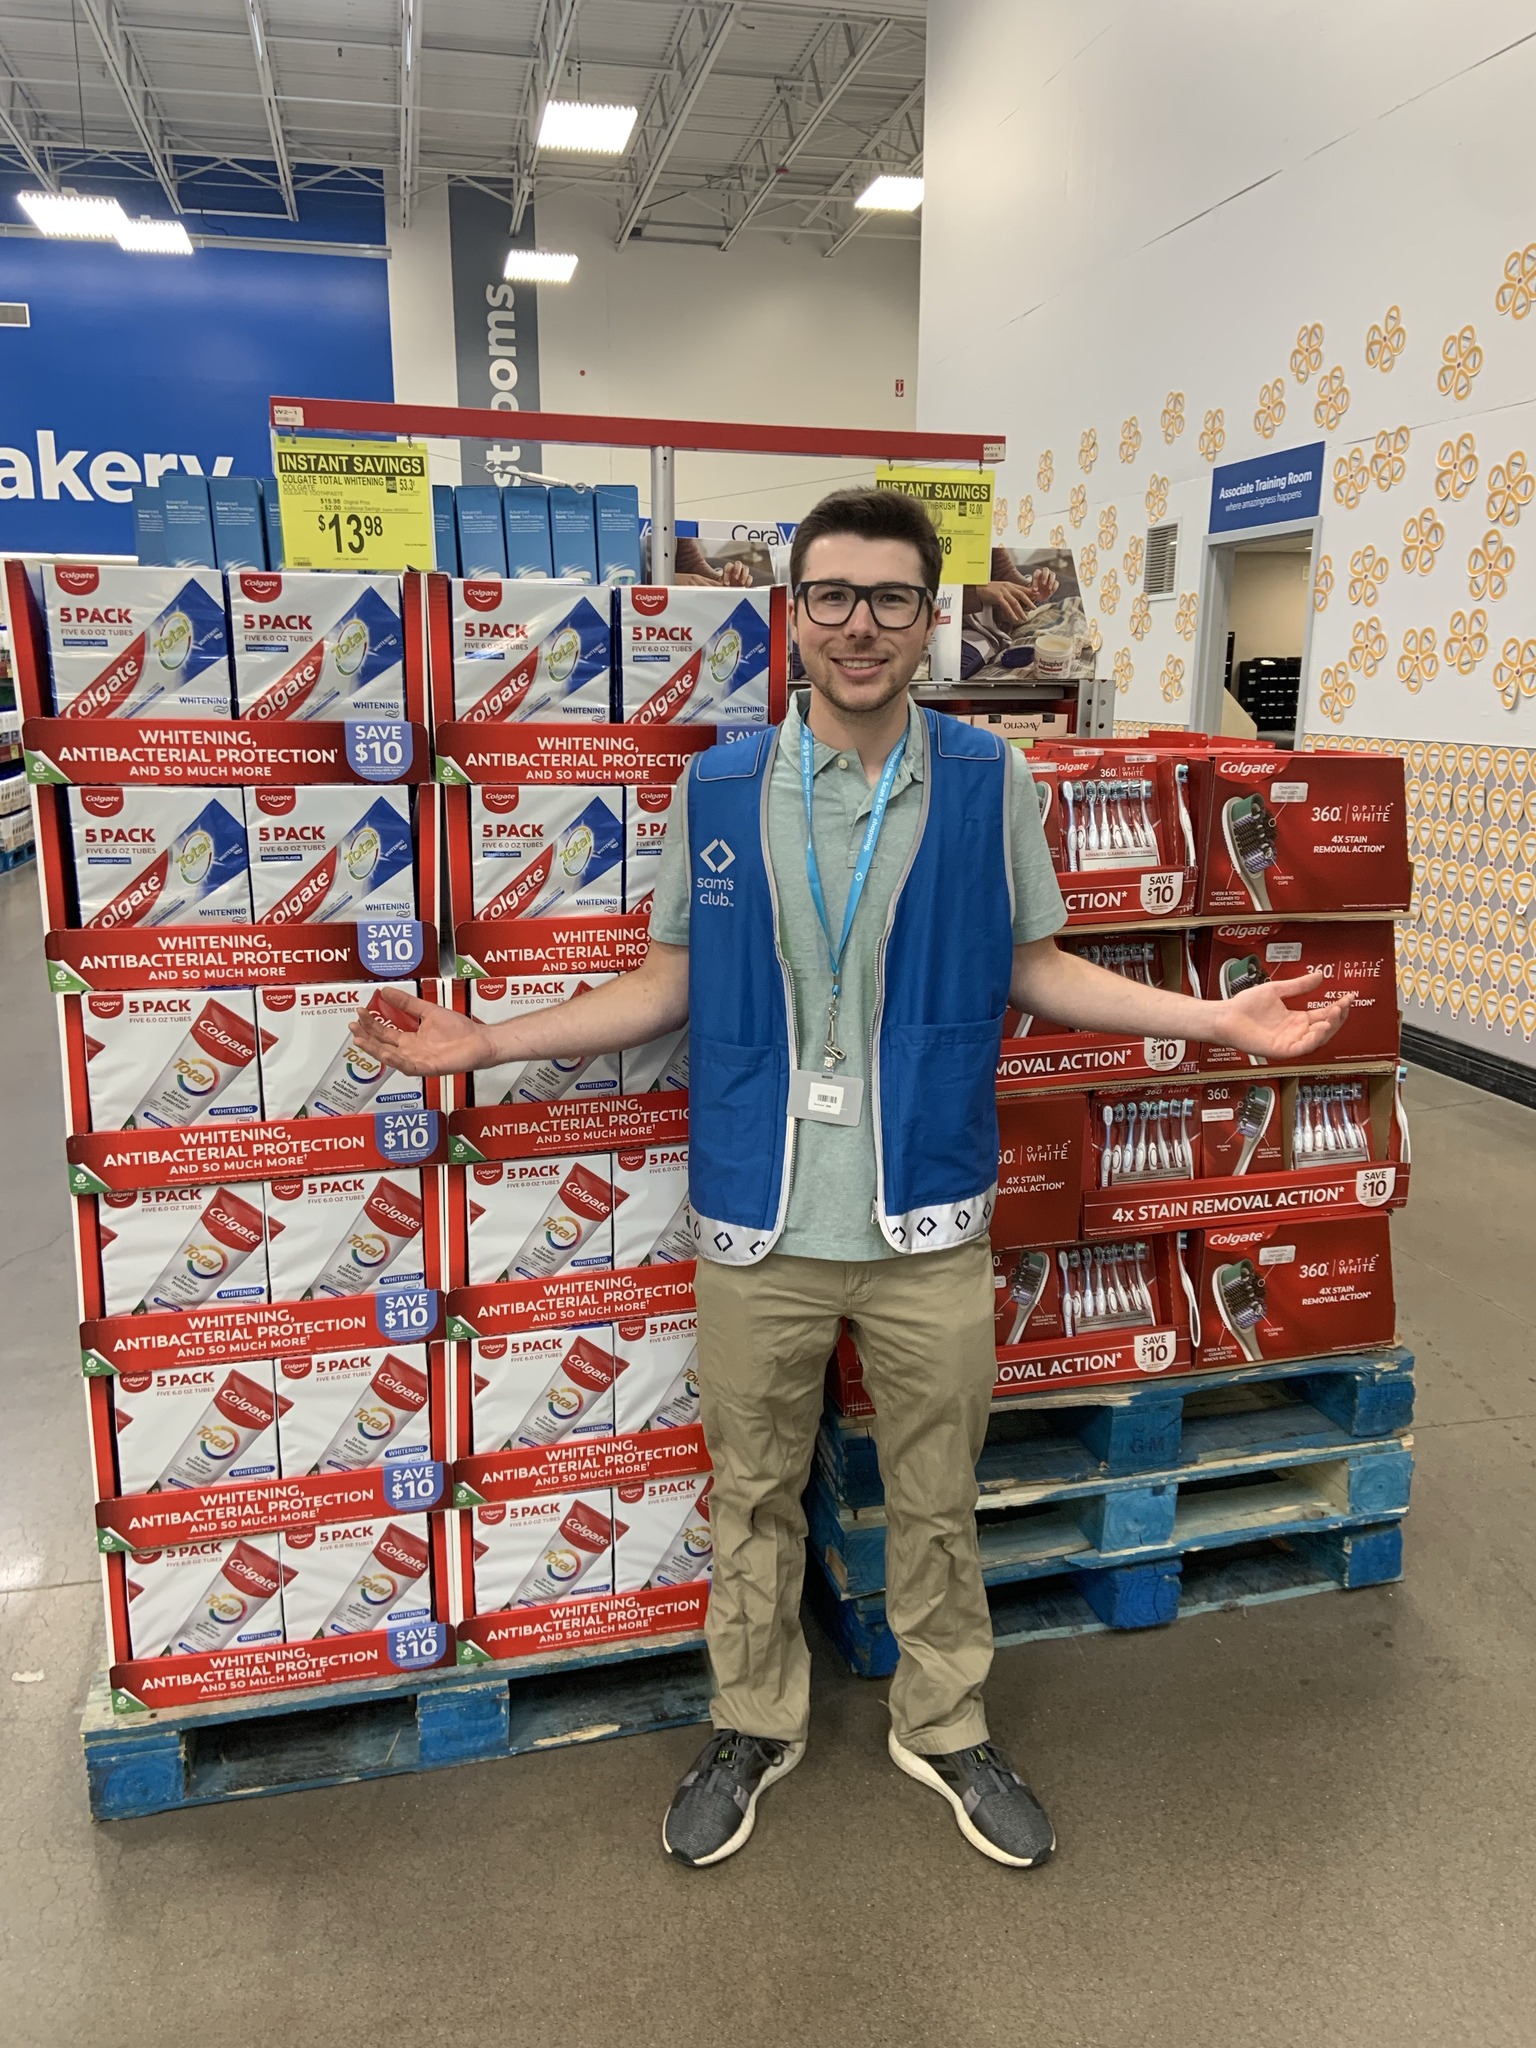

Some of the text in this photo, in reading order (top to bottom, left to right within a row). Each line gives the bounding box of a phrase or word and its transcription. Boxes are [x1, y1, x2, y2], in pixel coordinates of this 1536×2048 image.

[282, 455, 421, 474] INSTANT SAVINGS
[283, 475, 384, 486] COLGATE TOTAL WHITENING
[1219, 471, 1312, 499] Associate Training Room
[935, 485, 988, 499] SAVINGS
[1225, 490, 1302, 512] where amazingness happens
[732, 525, 796, 546] CeraV
[60, 571, 94, 580] Colgate
[60, 608, 132, 623] 5 PACK
[153, 620, 190, 654] Total
[464, 623, 528, 638] 5 PACK
[139, 730, 257, 747] WHITENING,
[355, 726, 402, 740] SAVE
[355, 742, 402, 764] $10
[537, 737, 639, 752] WHITENING,
[58, 747, 211, 762] ANTIBACTERIAL
[465, 753, 599, 766] ANTIBACTERIAL
[130, 766, 272, 776] AND SO MUCH MORE
[1220, 762, 1275, 776] Colgate
[879, 782, 888, 797] Scan
[86, 795, 119, 803] Colgate
[1352, 813, 1390, 822] WHITE
[85, 828, 155, 842] 5 PACK
[697, 878, 734, 890] sam's
[1150, 875, 1173, 885] SAVE
[576, 898, 617, 906] WHITENING
[1066, 891, 1127, 910] CTION
[1147, 886, 1174, 904] $10
[199, 908, 247, 916] WHITENING
[368, 925, 412, 938] SAVE
[1218, 925, 1269, 939] Colgate
[158, 935, 272, 950] WHITENING,
[367, 939, 413, 960] $10
[80, 952, 230, 969] ANTIBACTERIAL
[129, 1001, 139, 1013] 5
[144, 1000, 191, 1012] PACK
[200, 1020, 252, 1057] Colgate
[1152, 1043, 1177, 1061] $10
[172, 1058, 212, 1086] Total
[996, 1060, 1055, 1076] MOVAL
[547, 1099, 642, 1117] WHITENING,
[384, 1113, 428, 1128] SAVE
[480, 1118, 604, 1138] ANTIBACTERIAL
[180, 1127, 292, 1146] WHITENING,
[384, 1129, 428, 1149] $10
[103, 1147, 248, 1168] ANTIBACTERIAL
[252, 1136, 365, 1157] PROTECTION
[169, 1165, 198, 1175] AND
[202, 1162, 220, 1172] SO
[224, 1159, 262, 1170] MUCH
[1365, 1171, 1387, 1181] SAVE
[1363, 1181, 1387, 1197] $10
[566, 1182, 610, 1214] Colgate
[1112, 1208, 1134, 1222] 4x
[1138, 1202, 1187, 1220] STAIN
[1192, 1193, 1272, 1215] REMOVAL
[543, 1217, 576, 1241] Total
[1209, 1232, 1263, 1246] Colgate
[1339, 1264, 1375, 1275] WHITE
[188, 1309, 295, 1330] WHITENING,
[114, 1329, 252, 1352] ANTIBACTERIAL
[258, 1317, 366, 1341] PROTECTION
[1143, 1335, 1166, 1345] SAVE
[1142, 1345, 1168, 1363] $10
[996, 1362, 1045, 1382] OVAL
[393, 1466, 434, 1481] SAVE
[200, 1485, 304, 1507] WHITENING,
[392, 1480, 434, 1500] $10
[129, 1489, 374, 1530] ANTIBACTERIAL PROTECTION
[550, 1597, 640, 1619] WHITENING,
[487, 1599, 700, 1642] ANTIBACTERIAL PROTECTION
[210, 1648, 310, 1669] WHITENING,
[142, 1649, 378, 1691] ANTIBACTERIAL PROTECTION
